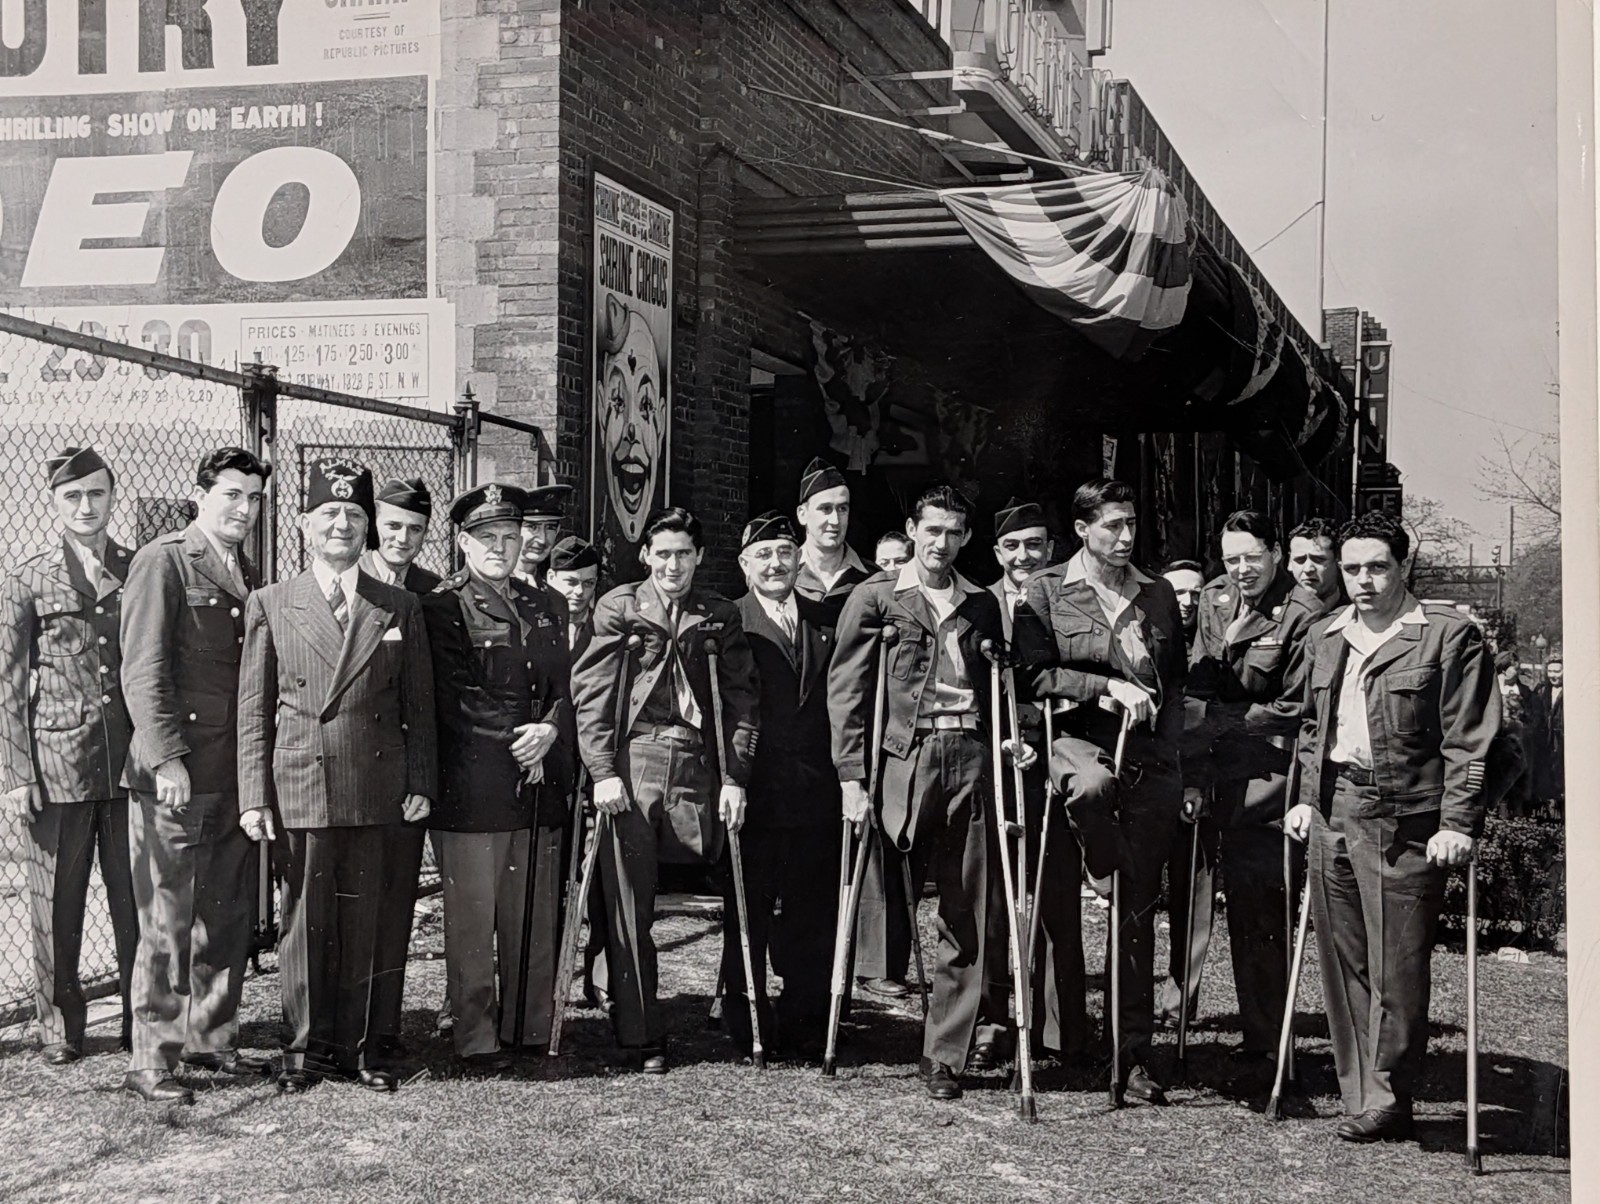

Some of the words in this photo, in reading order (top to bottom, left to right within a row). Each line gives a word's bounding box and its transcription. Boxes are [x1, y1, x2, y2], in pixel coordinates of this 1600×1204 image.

[339, 26, 387, 40] COURTESY
[394, 24, 405, 36] OF
[323, 46, 368, 60] REPUBLIC
[373, 42, 420, 56] PICTURES
[107, 110, 175, 137] SHOW
[187, 107, 216, 131] ON
[600, 233, 634, 297] SHRINE
[637, 249, 668, 309] CIRCUS
[248, 326, 296, 339] PRICES
[308, 323, 355, 338] MATINEES
[375, 322, 421, 336] EVENINGS
[319, 458, 365, 476] ALMAS
